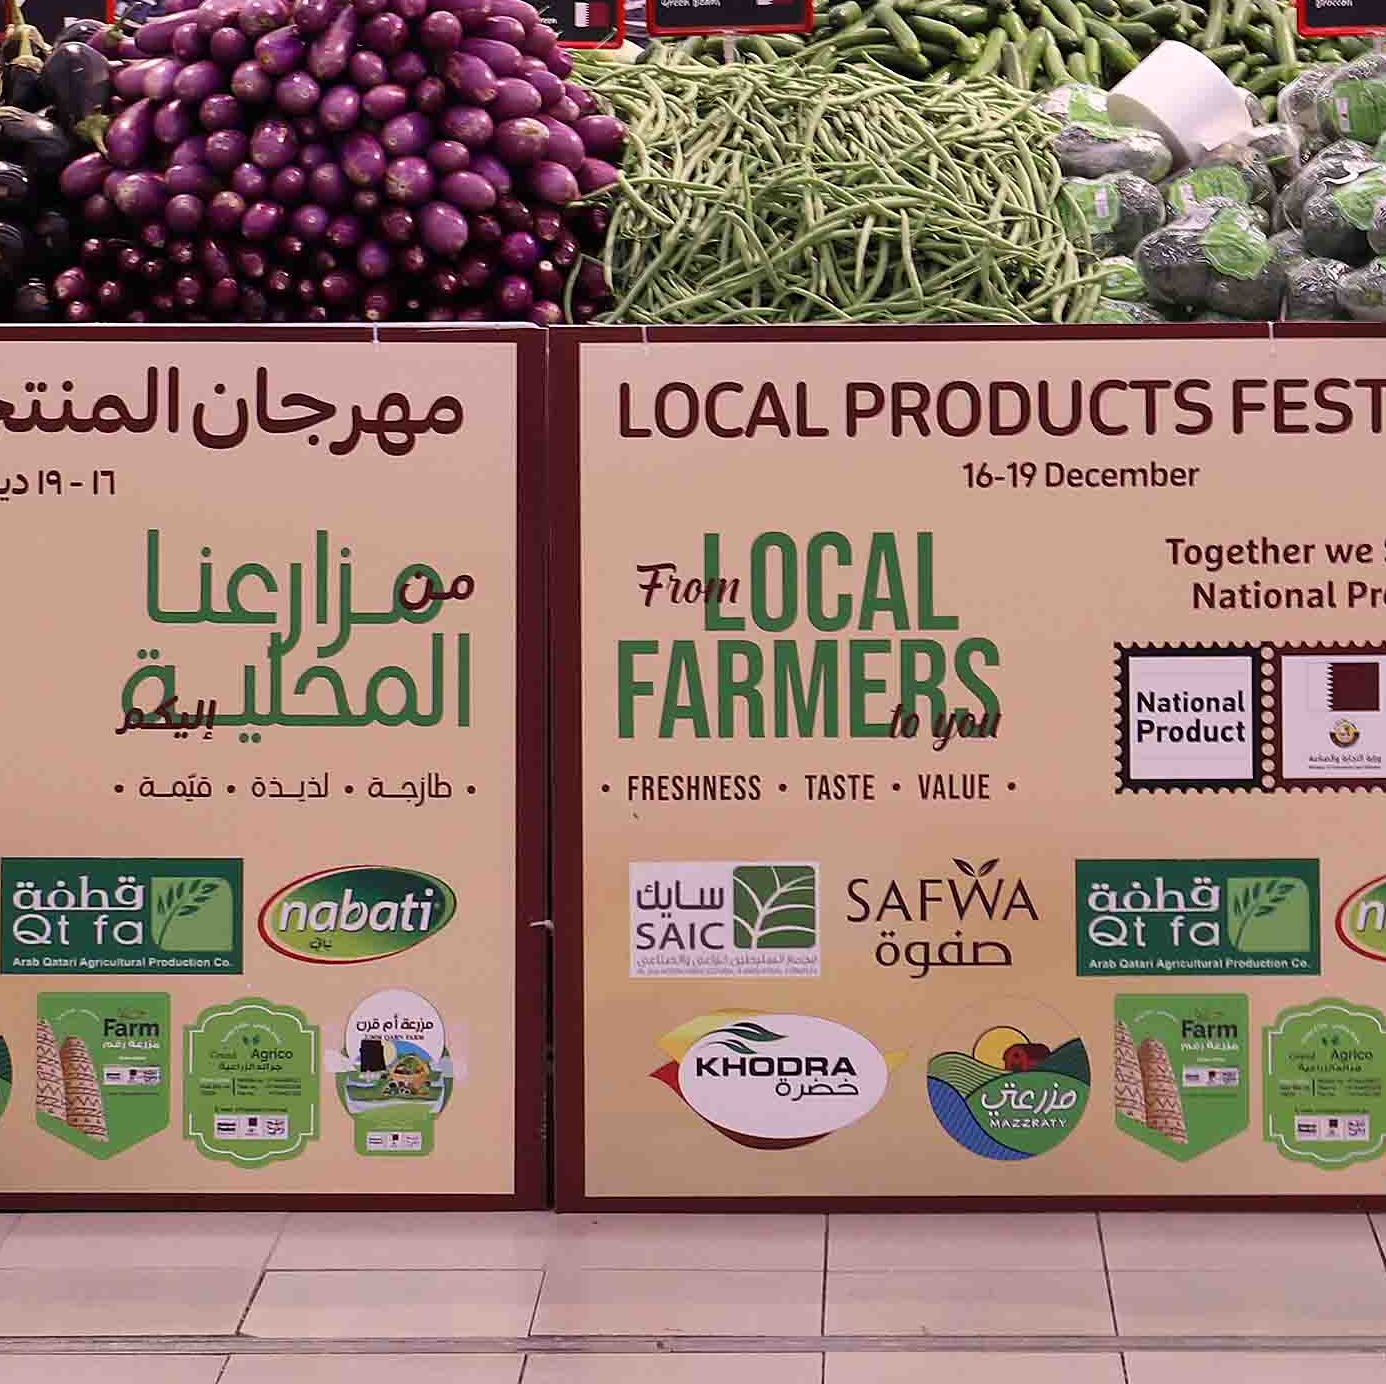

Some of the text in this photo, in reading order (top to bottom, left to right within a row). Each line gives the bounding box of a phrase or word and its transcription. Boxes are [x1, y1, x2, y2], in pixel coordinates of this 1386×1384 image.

[193, 367, 463, 456] مهرجان
[620, 382, 829, 438] LOCAL
[846, 379, 1213, 437] PRODUCTS
[1046, 461, 1200, 488] December
[1165, 537, 1315, 572] Together
[1325, 544, 1373, 563] we
[703, 530, 960, 634] LOCAL
[1194, 581, 1336, 609] National
[615, 638, 1001, 742] FARMERS
[279, 887, 435, 933] nabati
[12, 957, 233, 969] Arab Qatari Agricultural Production Co.
[103, 1019, 160, 1039] Farm
[251, 1048, 294, 1062] Agrico
[697, 1057, 856, 1076] KHODRA
